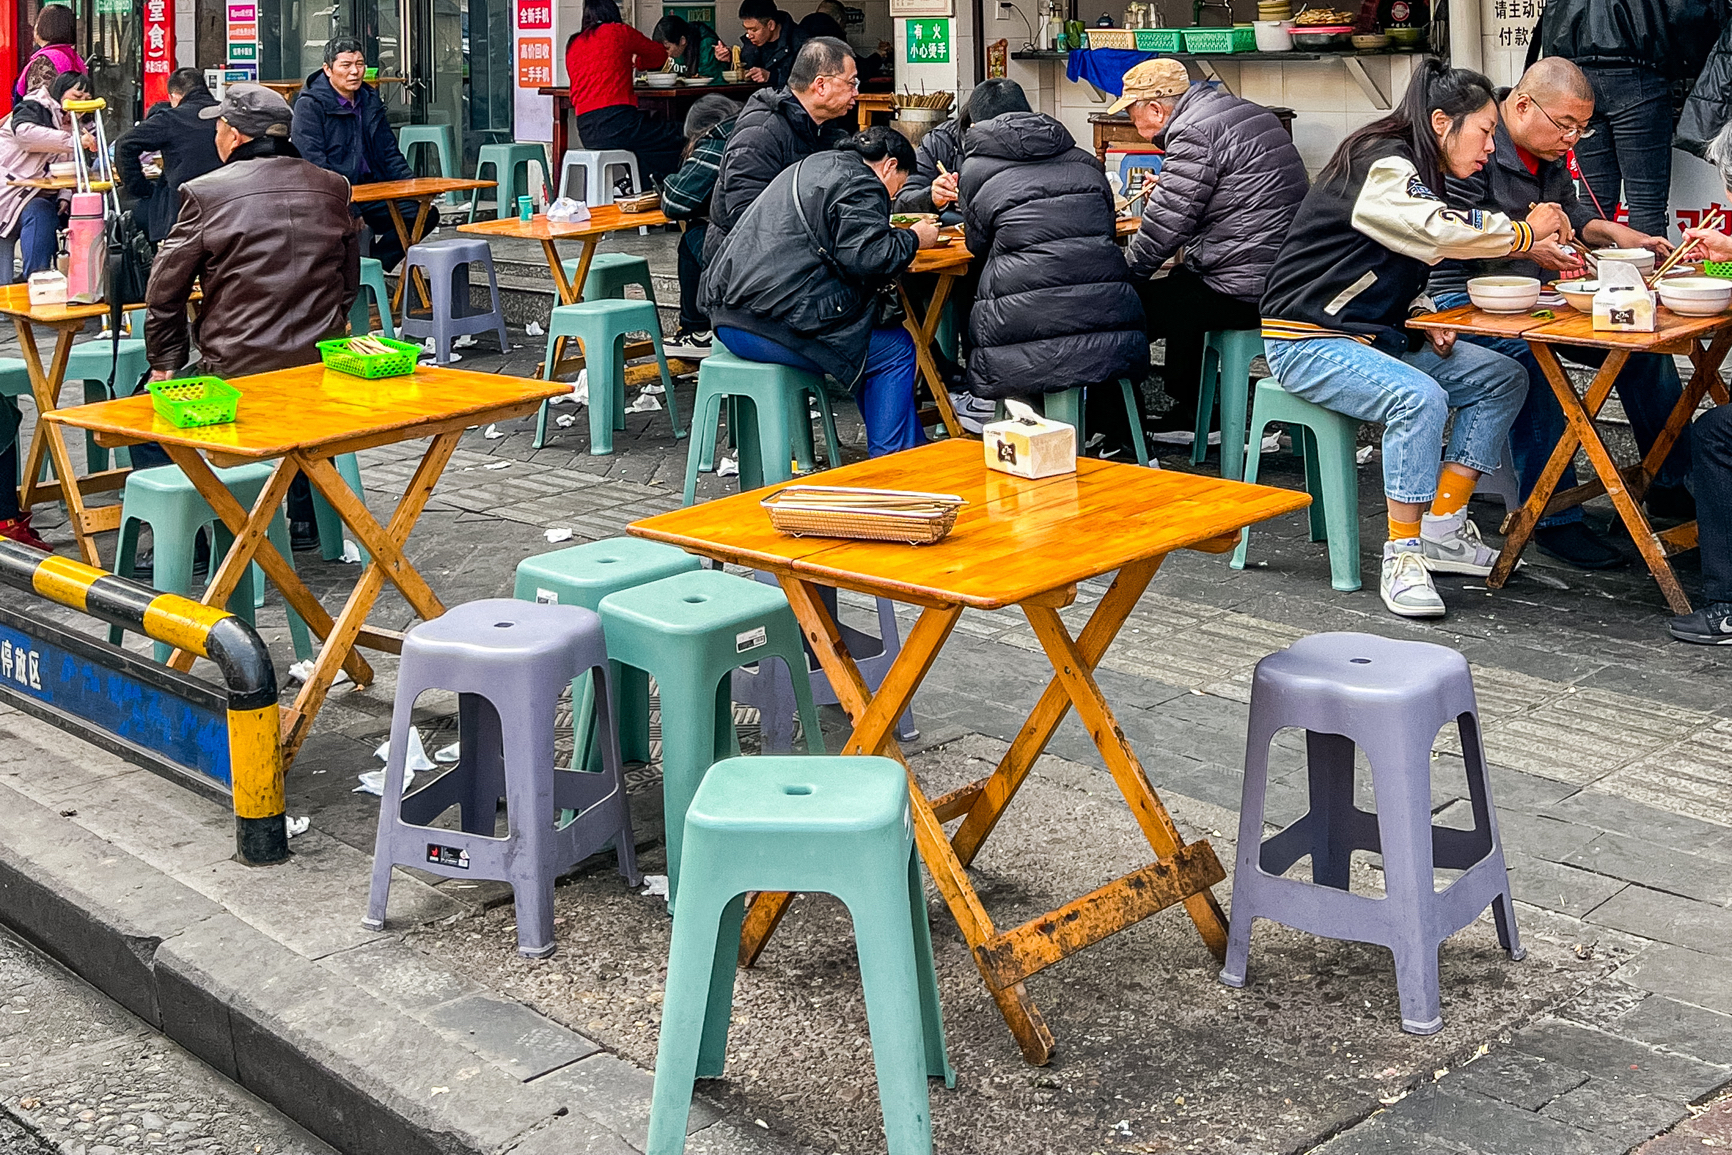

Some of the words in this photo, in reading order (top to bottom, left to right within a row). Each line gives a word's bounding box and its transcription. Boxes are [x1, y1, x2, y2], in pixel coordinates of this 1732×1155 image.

[520, 7, 549, 24] 全新手机
[914, 23, 942, 40] 有火
[1499, 26, 1536, 47] 付款
[520, 43, 550, 60] 高价回收
[910, 42, 947, 59] 小心烫手
[520, 66, 551, 83] 二手手机
[1, 639, 42, 691] 停放区
